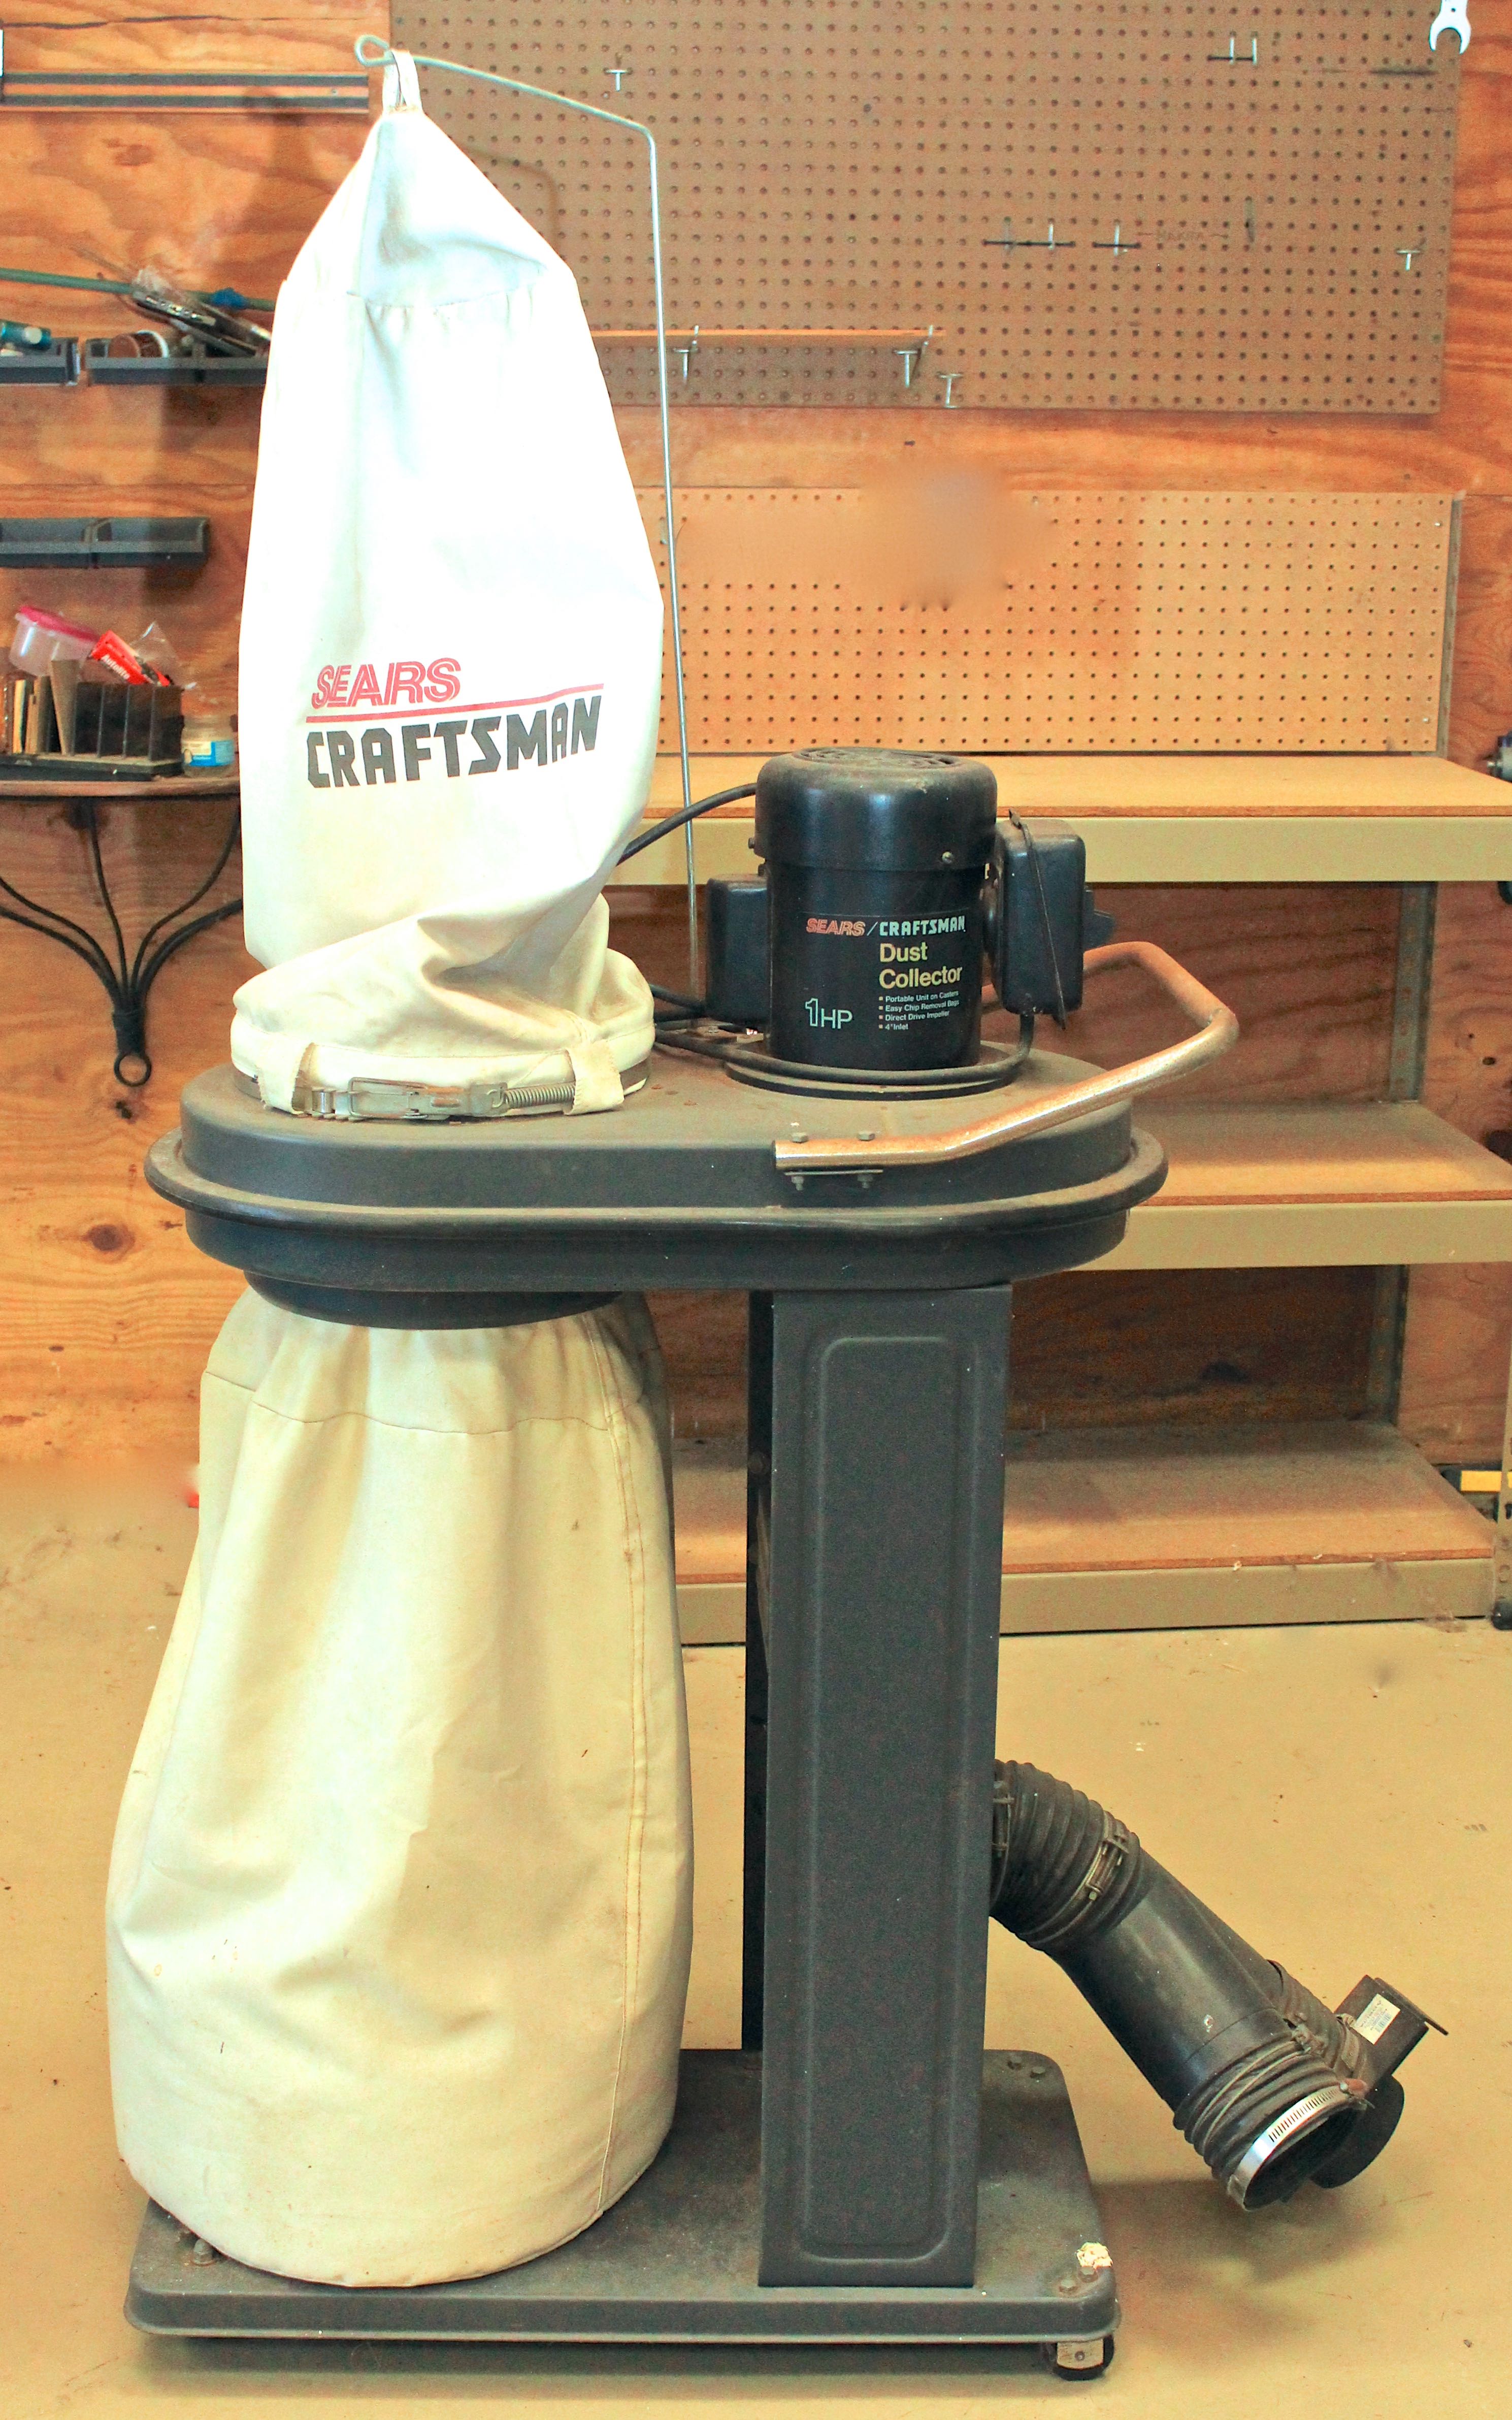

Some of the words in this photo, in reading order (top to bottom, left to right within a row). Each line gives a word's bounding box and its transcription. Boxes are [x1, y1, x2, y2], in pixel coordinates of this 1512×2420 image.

[311, 657, 462, 710] SEARS
[306, 695, 602, 788] CRAFTSMAN
[879, 942, 928, 962] Dust
[879, 965, 963, 989] Collector
[939, 990, 959, 999] Casters
[885, 1005, 902, 1013] Easy
[904, 1004, 920, 1012] Chip
[921, 1001, 946, 1010] Removal
[927, 1011, 949, 1019] Impeller
